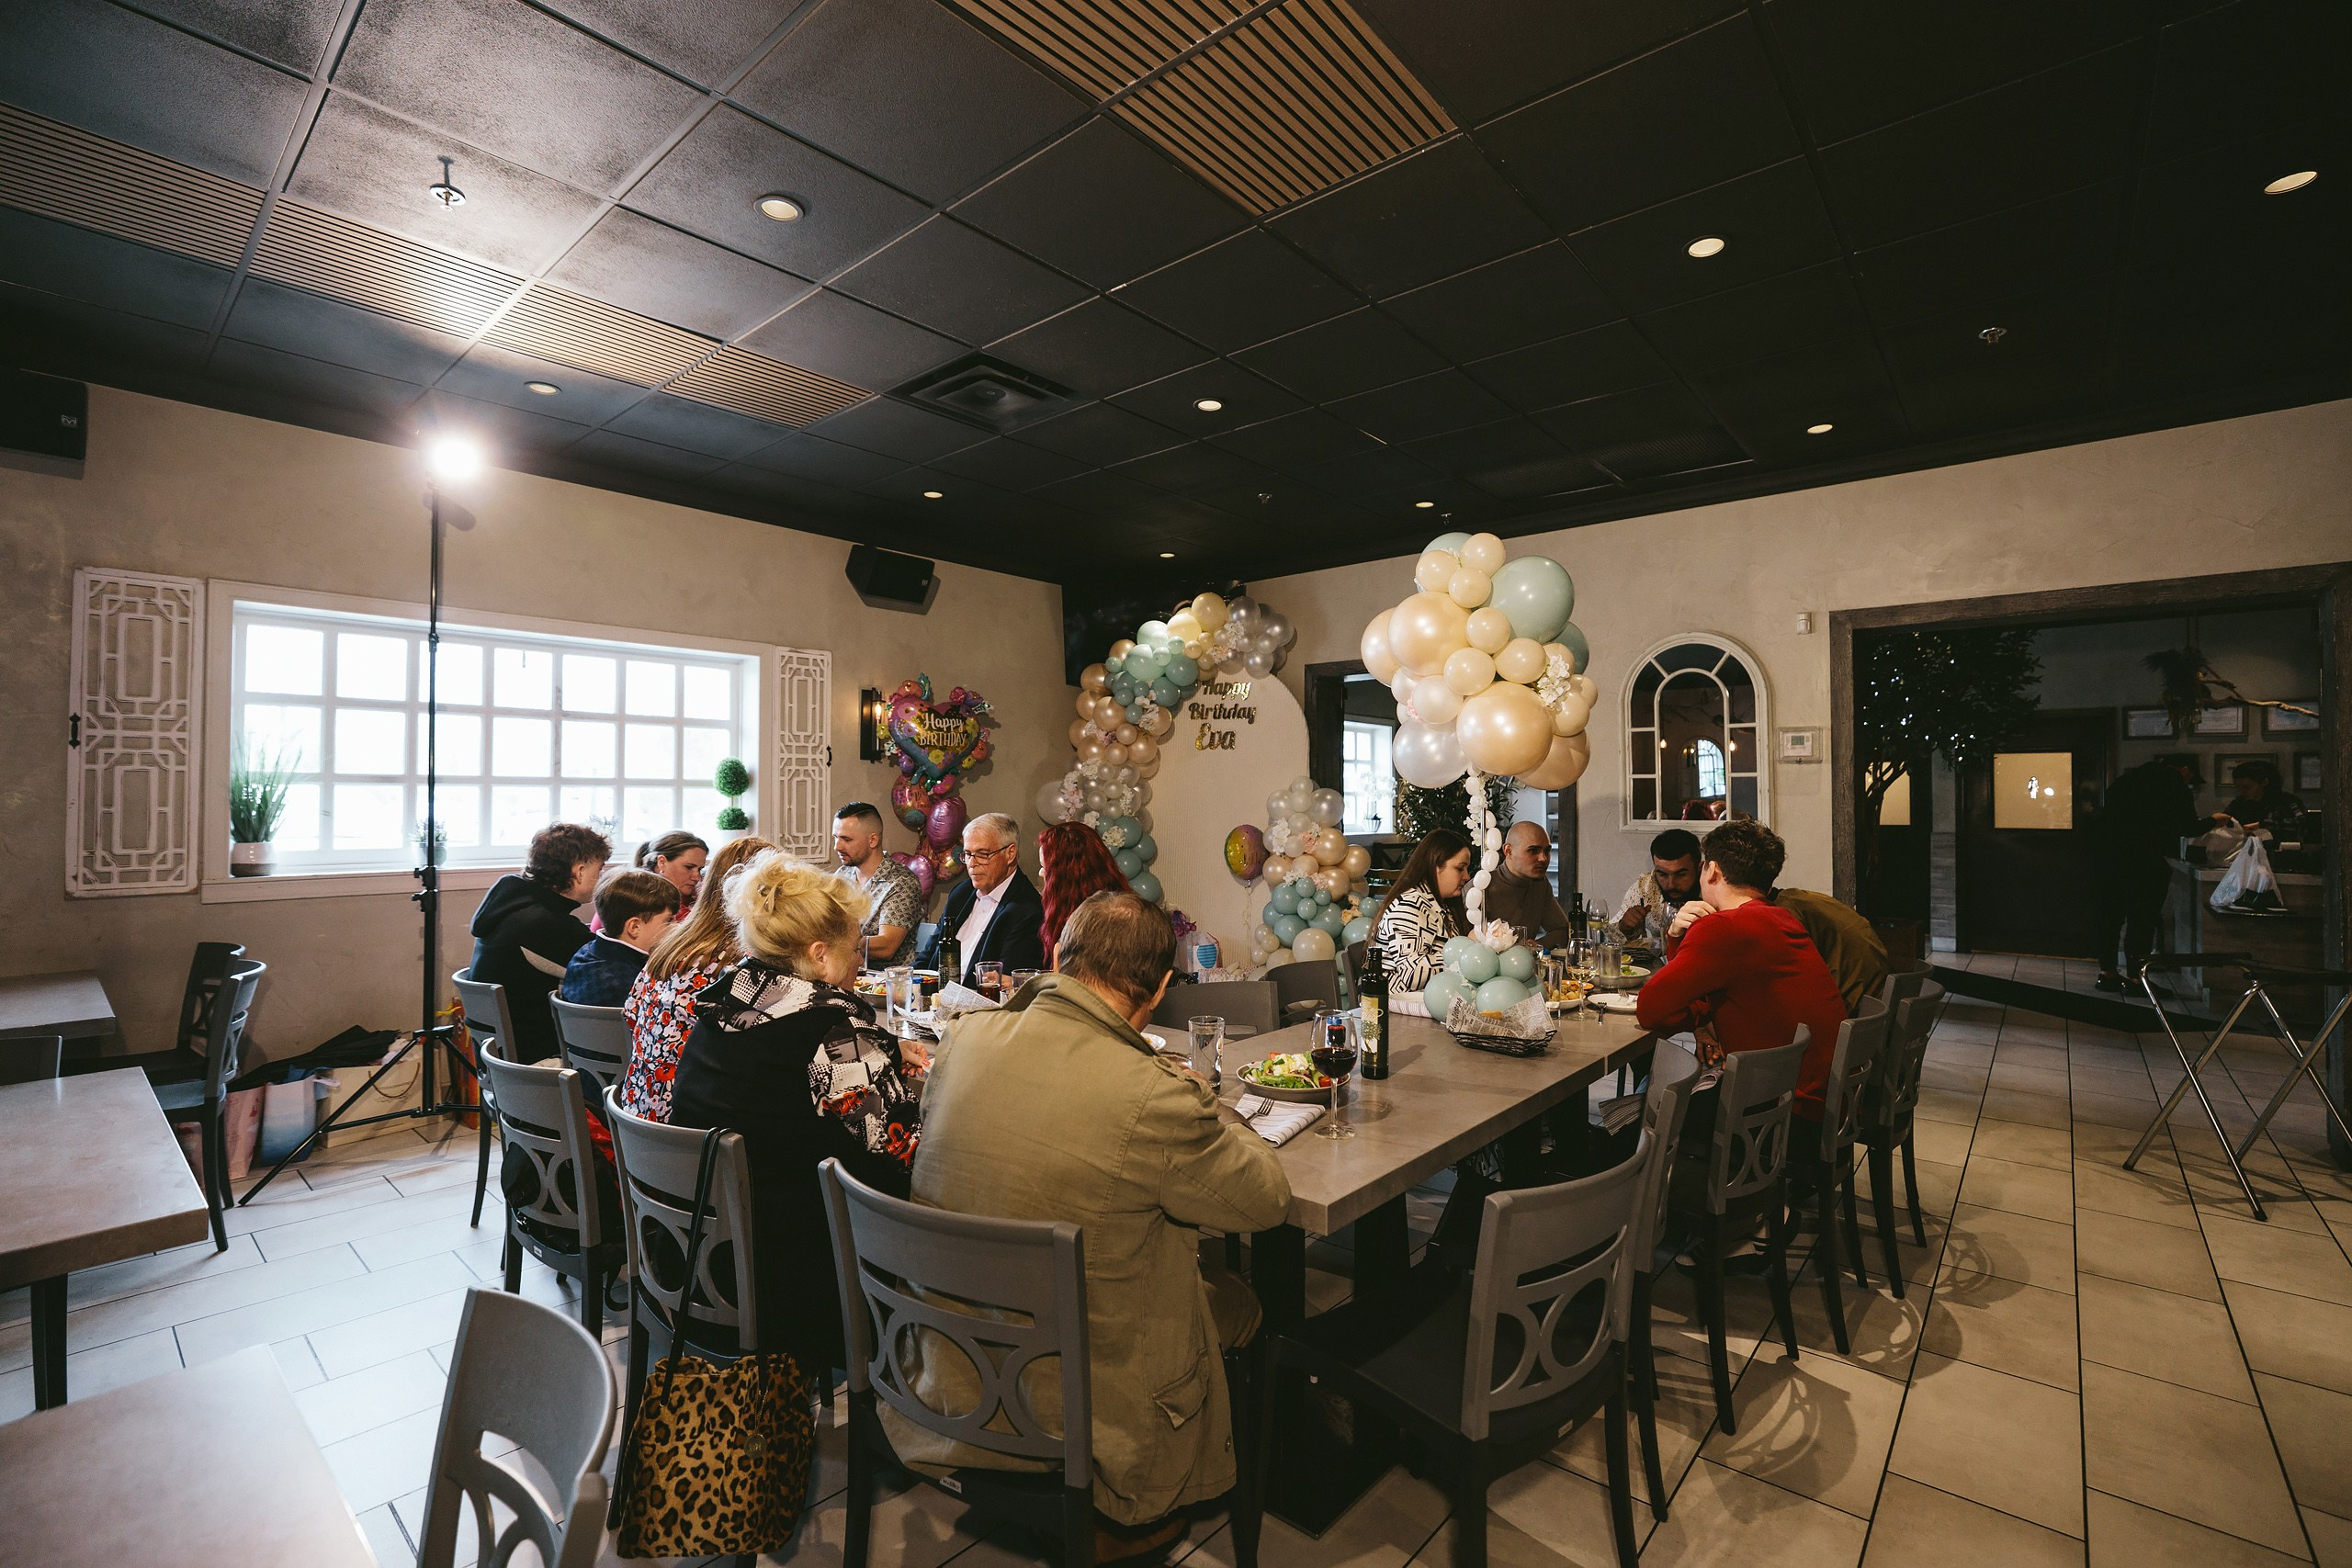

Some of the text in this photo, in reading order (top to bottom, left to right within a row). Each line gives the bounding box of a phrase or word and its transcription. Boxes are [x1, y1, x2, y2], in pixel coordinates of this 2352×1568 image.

[1202, 680, 1251, 701] Happy
[921, 712, 964, 733] Happy
[1188, 702, 1257, 725] Birthday
[919, 731, 967, 747] BIRTHDAY
[1195, 722, 1237, 750] Eva
